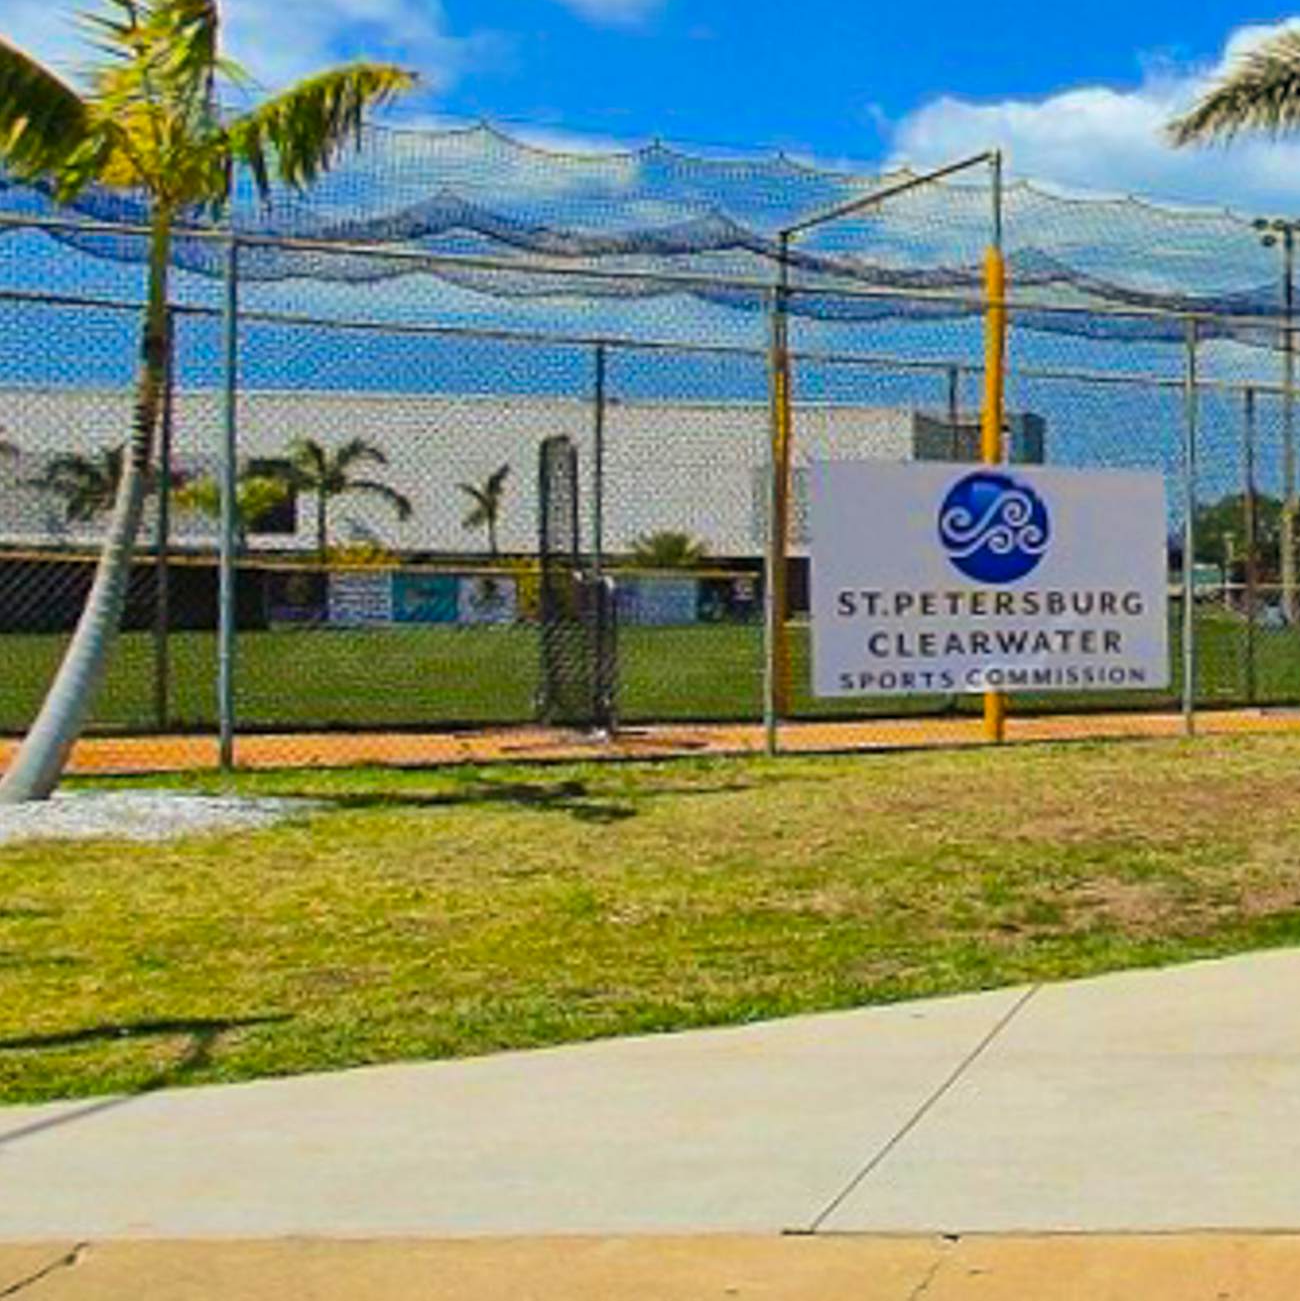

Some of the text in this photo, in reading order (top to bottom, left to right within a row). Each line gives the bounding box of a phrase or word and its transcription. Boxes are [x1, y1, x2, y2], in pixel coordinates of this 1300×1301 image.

[867, 630, 1123, 658] CLEARWATER
[840, 666, 1147, 690] SPORTS COMMISSION
